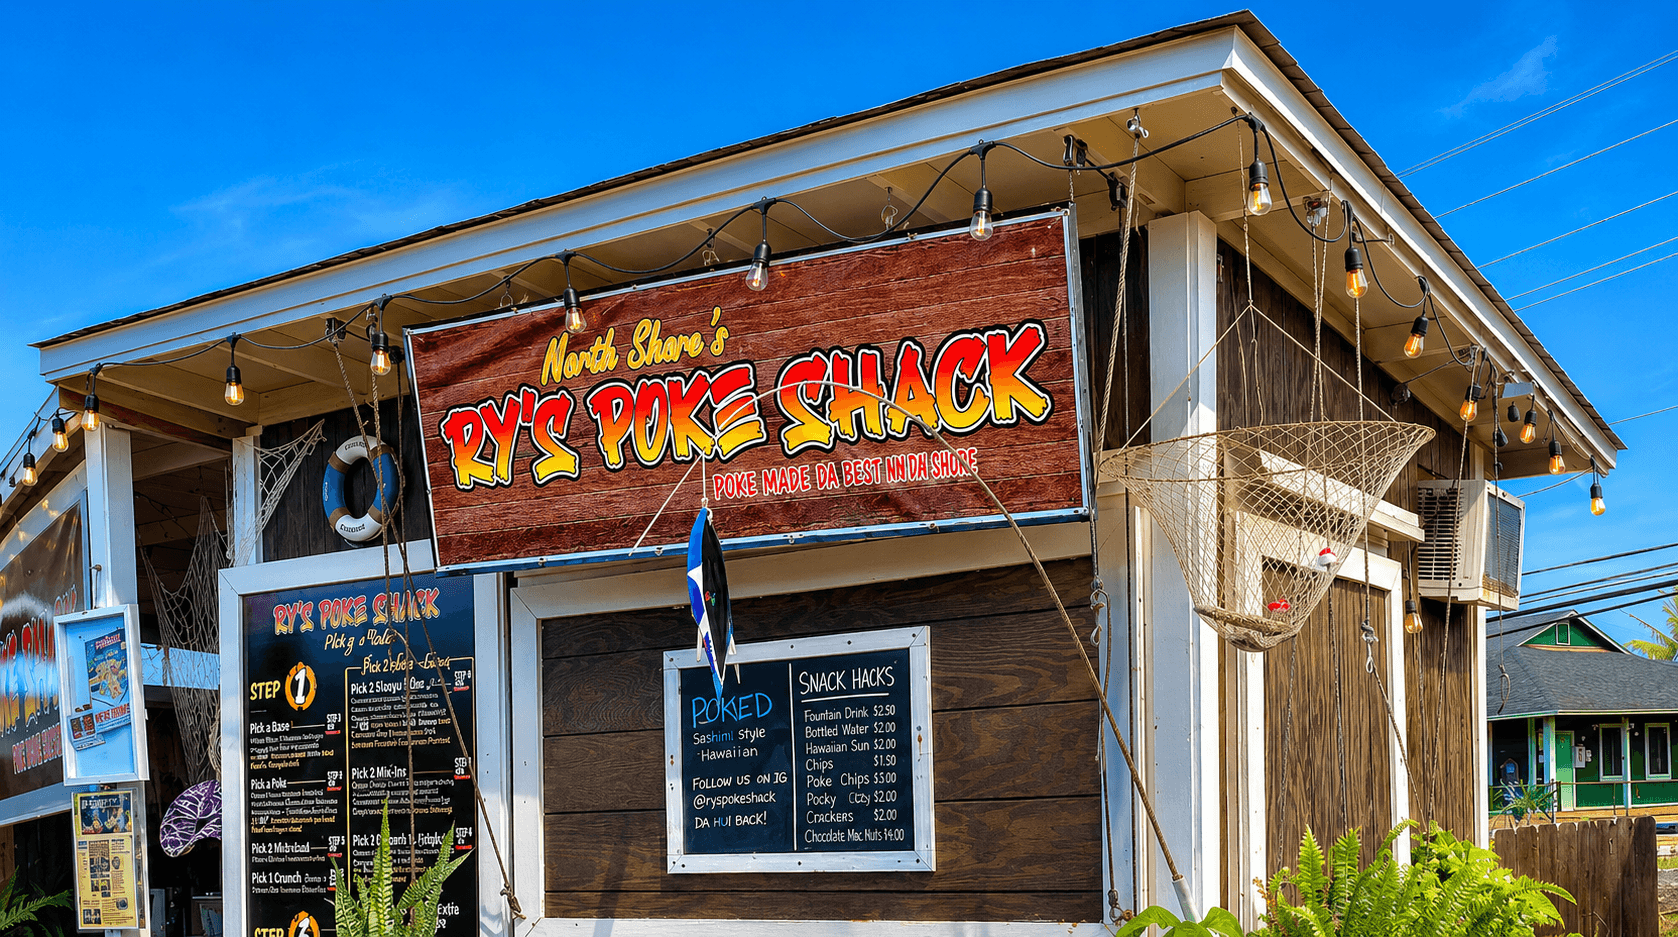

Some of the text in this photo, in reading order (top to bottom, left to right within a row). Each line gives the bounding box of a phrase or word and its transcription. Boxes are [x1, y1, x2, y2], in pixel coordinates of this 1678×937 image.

[541, 306, 729, 386] North Shore's
[440, 319, 1054, 489] RY'S POKE SHACK
[713, 471, 757, 500] POKE
[762, 465, 811, 496] MADE
[816, 462, 839, 490] DA
[842, 457, 882, 487] BEST
[273, 600, 314, 635] RY'S
[319, 595, 368, 630] POKE
[250, 668, 306, 704] STEP 1
[351, 682, 368, 695] Pick
[369, 681, 374, 693] 2
[799, 665, 895, 695] SNACK HACKS
[692, 692, 773, 728] POKED
[804, 708, 842, 723] Fountain
[844, 705, 869, 719] Drink
[250, 722, 265, 734] Pick
[272, 721, 290, 732] Base
[738, 727, 766, 743] Style
[805, 724, 838, 739] Bottled
[841, 723, 869, 736] Water
[805, 740, 848, 755] Hawaiian
[850, 739, 870, 752] Sun
[805, 754, 897, 774] Chips $1.50
[351, 767, 369, 780] Pick
[370, 767, 376, 779] 2
[692, 776, 732, 791] FOLLOW
[736, 774, 751, 786] US
[756, 773, 771, 784] ON
[806, 774, 833, 789] Poke
[840, 772, 870, 789] Chips
[250, 777, 287, 790] Pick a Poke
[693, 790, 776, 810] @ryspokeshack
[806, 792, 837, 809] Pocky
[694, 810, 767, 830] DA HUI BACK!
[251, 842, 267, 854] Pick
[352, 834, 369, 847] Pick
[370, 834, 375, 846] 2
[251, 871, 267, 884] Pick
[268, 872, 273, 884] 1
[274, 870, 302, 884] Crunch
